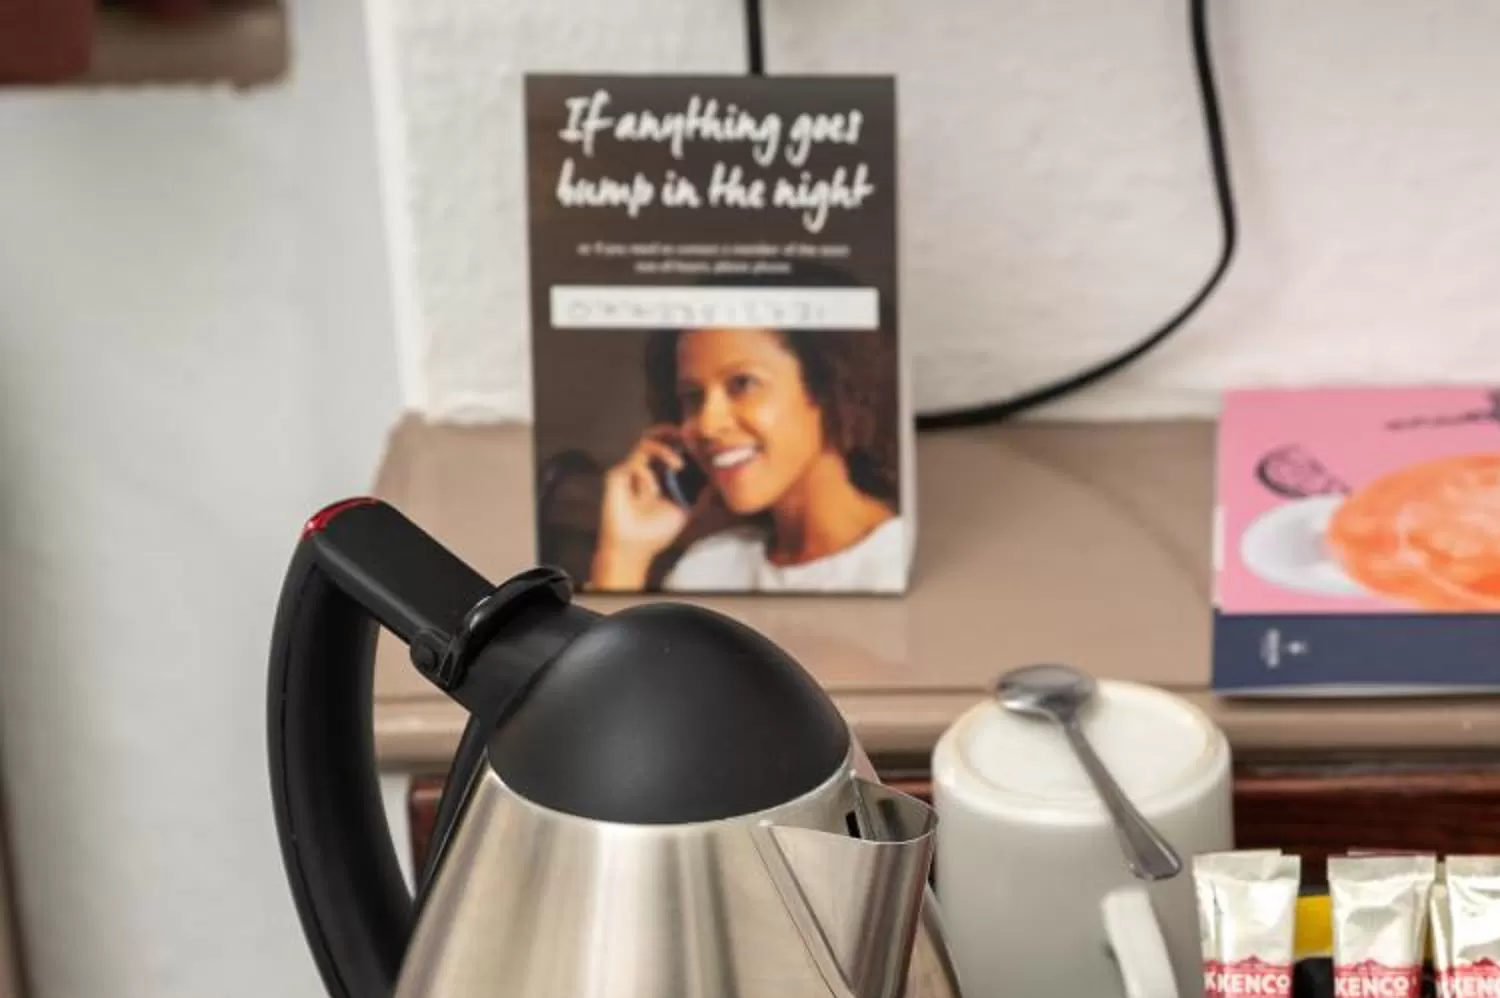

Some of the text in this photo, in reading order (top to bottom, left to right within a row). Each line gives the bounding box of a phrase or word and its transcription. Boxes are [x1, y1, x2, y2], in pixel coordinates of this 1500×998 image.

[559, 89, 863, 166] If anything goes
[557, 158, 874, 234] bump in the night
[1217, 972, 1291, 994] KENCO
[1334, 976, 1409, 998] KENCO
